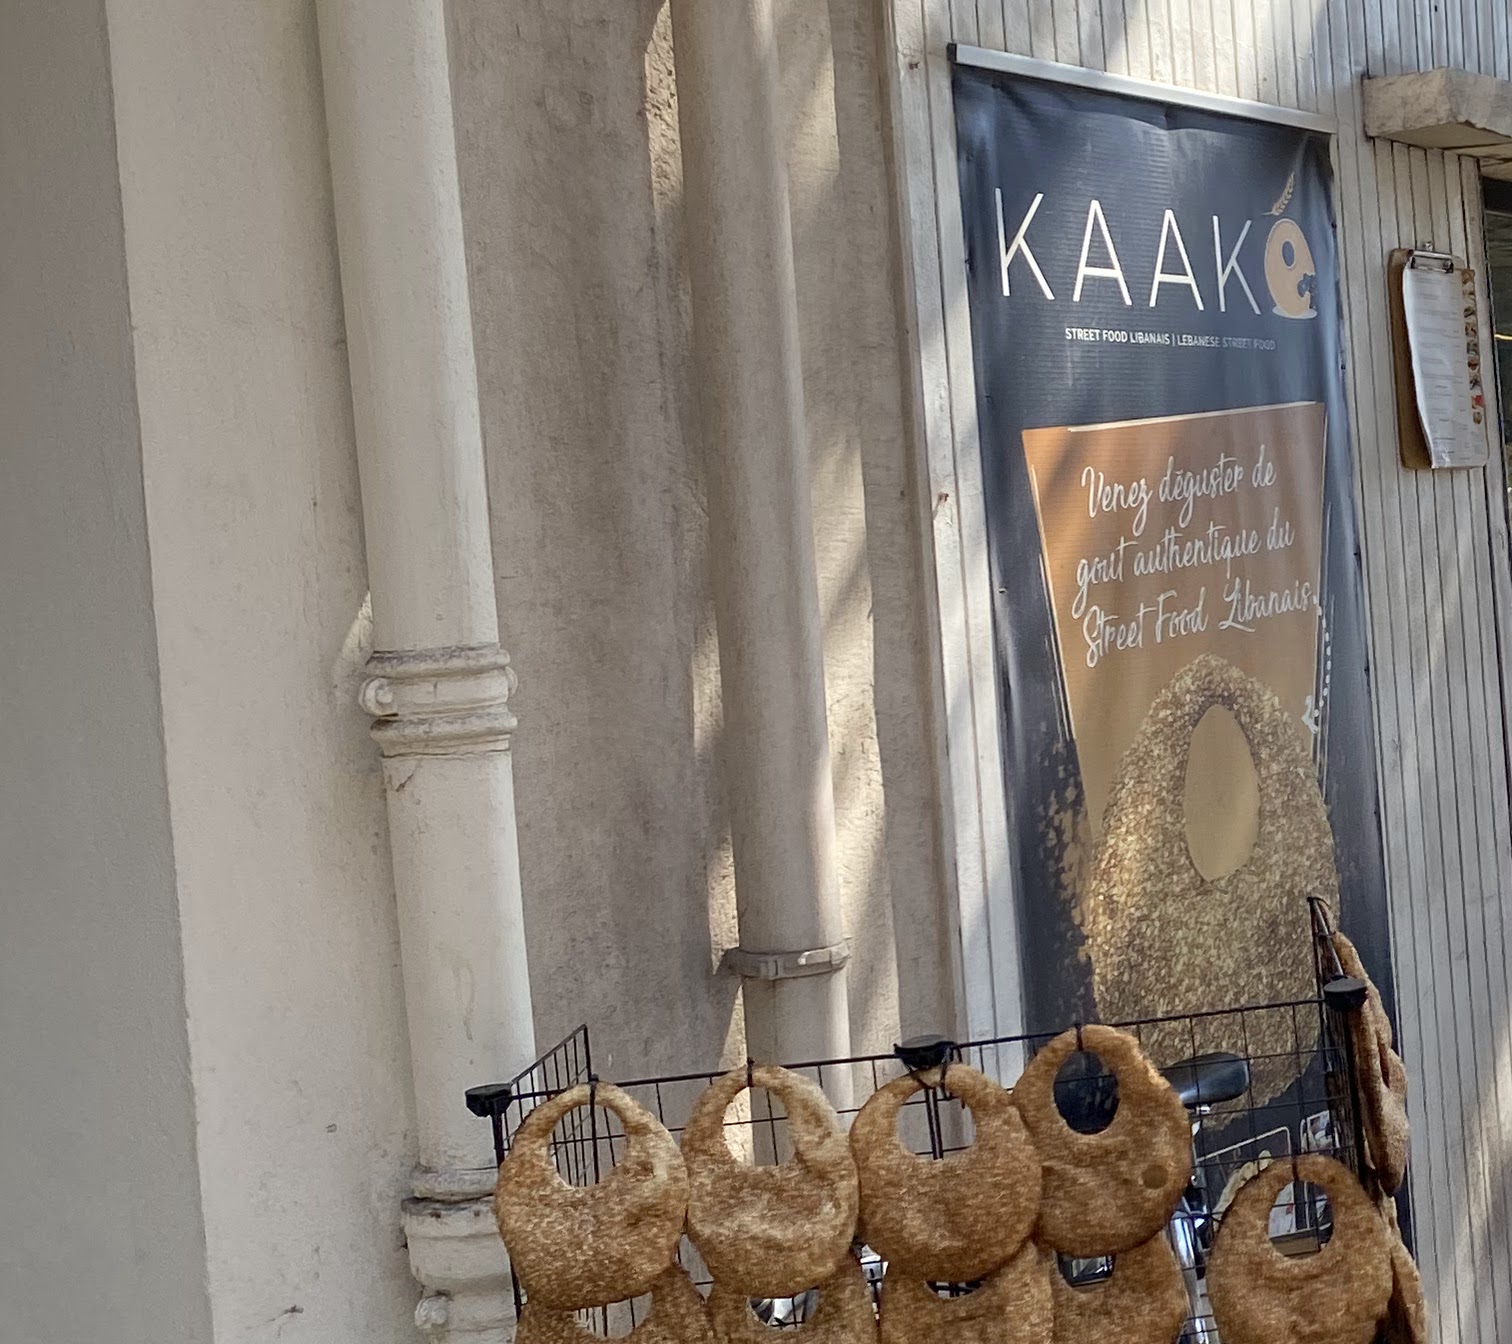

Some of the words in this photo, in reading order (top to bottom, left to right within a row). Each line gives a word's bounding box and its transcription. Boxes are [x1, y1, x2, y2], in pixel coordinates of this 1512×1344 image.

[1065, 327, 1100, 342] STREET
[1102, 329, 1128, 343] FOOD
[1129, 331, 1170, 346] LIBANAIS
[1177, 335, 1221, 348] LEBANESE
[1222, 337, 1252, 349] STREET
[1254, 339, 1276, 351] FOOD
[1081, 466, 1154, 537] Venez
[1159, 455, 1244, 528] déguster
[1252, 444, 1277, 488] de
[1133, 520, 1264, 579] authentique
[1266, 507, 1295, 551] du
[1082, 605, 1157, 668] Street
[1154, 587, 1210, 643] Food
